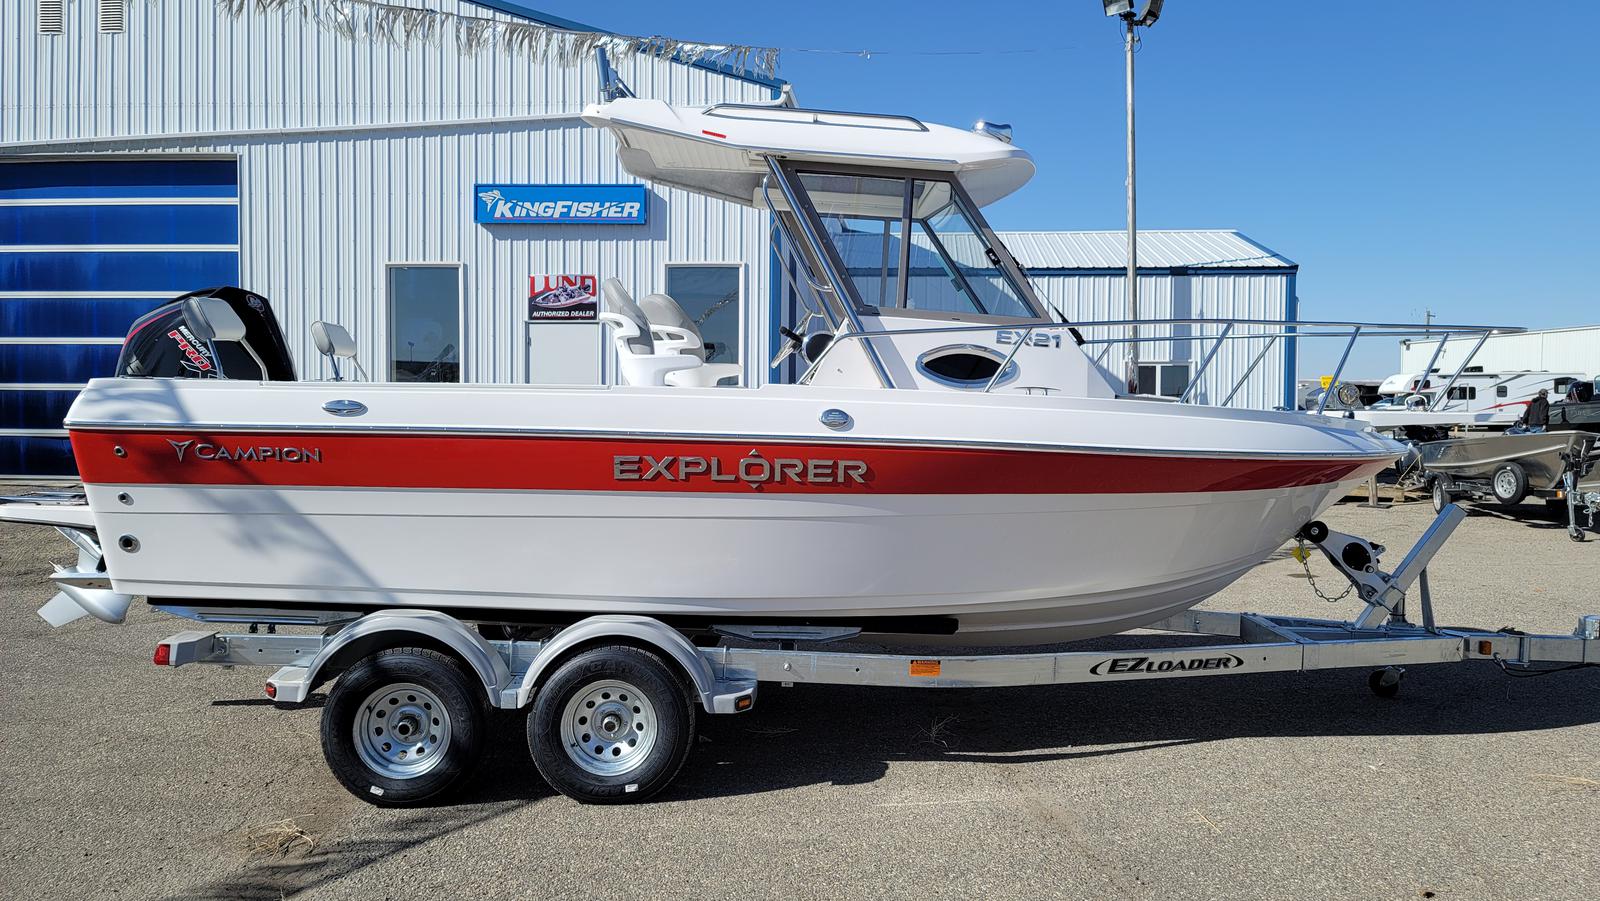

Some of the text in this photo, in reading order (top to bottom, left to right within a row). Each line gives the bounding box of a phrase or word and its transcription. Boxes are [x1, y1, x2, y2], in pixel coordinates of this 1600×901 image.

[494, 200, 641, 218] KINGFISHER
[529, 275, 597, 298] LUND
[532, 310, 570, 318] AUTHORIZED
[995, 330, 1062, 348] EX21
[194, 443, 321, 463] CAMPION
[613, 454, 868, 484] EXPLORER
